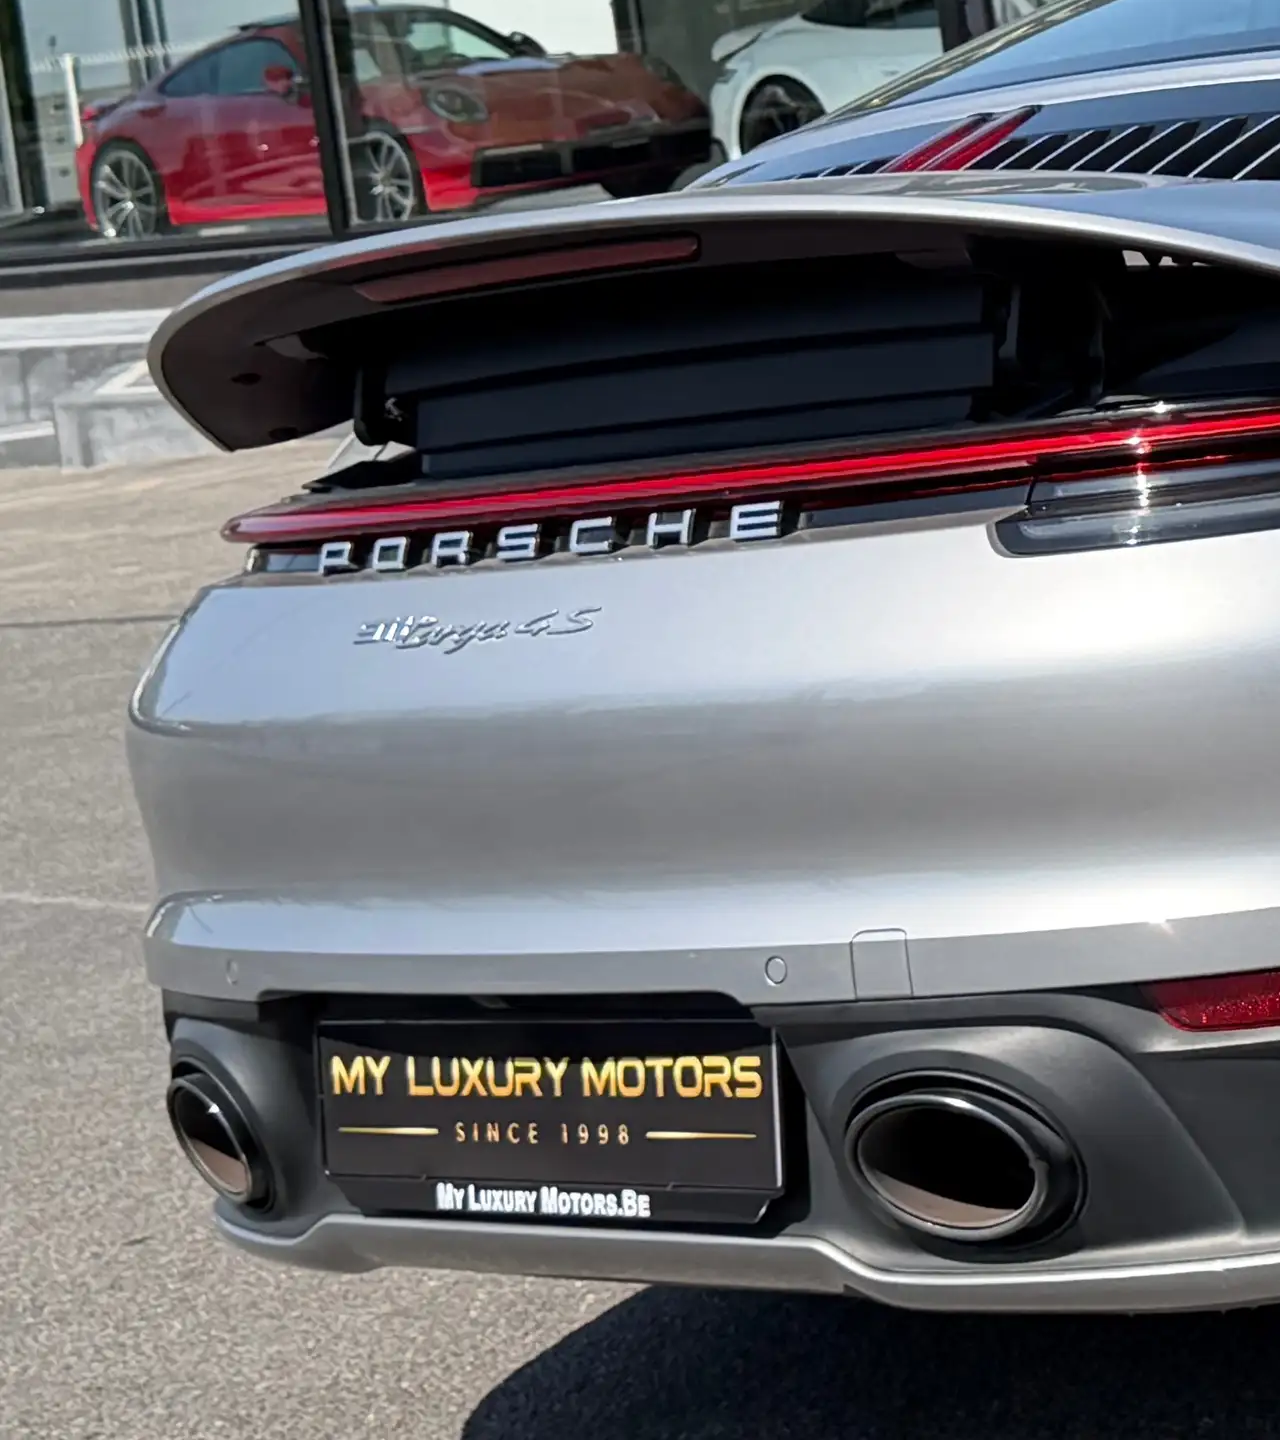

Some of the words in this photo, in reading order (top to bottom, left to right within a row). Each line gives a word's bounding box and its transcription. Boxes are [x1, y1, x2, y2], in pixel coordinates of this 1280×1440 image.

[318, 500, 785, 573] PORSCHE
[514, 606, 602, 637] 4S
[331, 1055, 391, 1096] MY
[406, 1055, 570, 1098] LUXURY
[581, 1056, 762, 1099] MOTORS
[455, 1122, 539, 1145] SINCE
[560, 1124, 631, 1146] 1998
